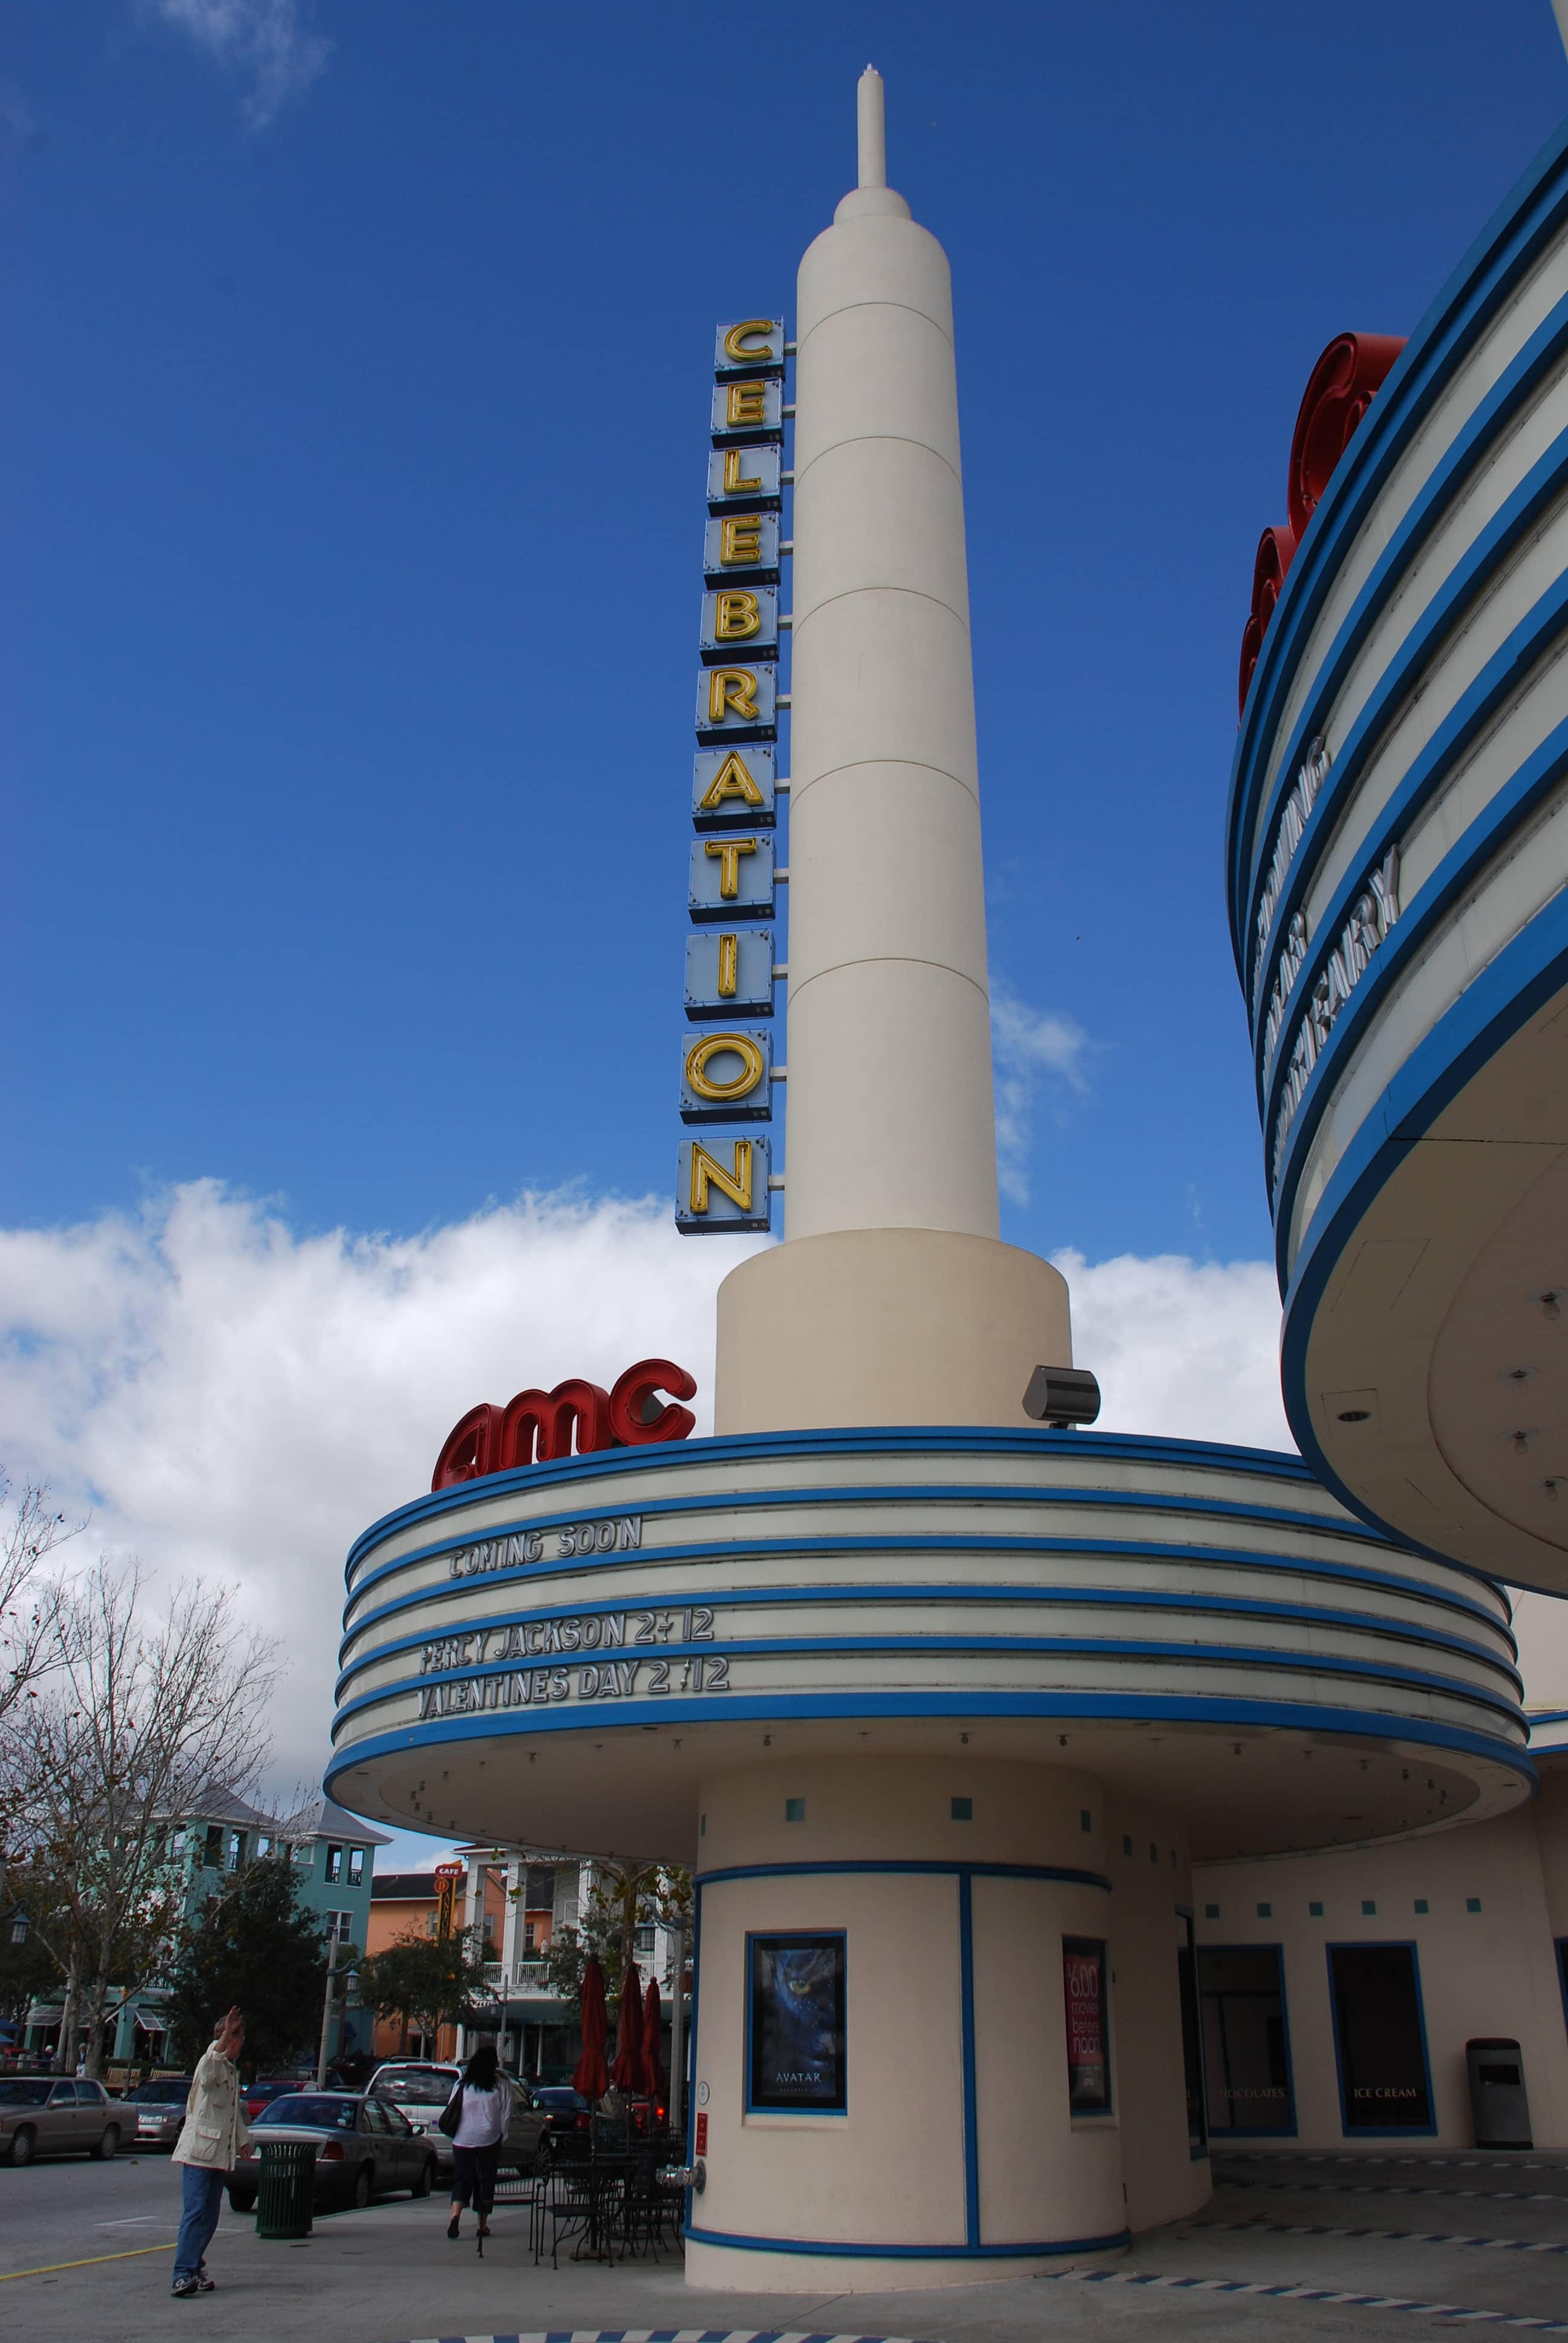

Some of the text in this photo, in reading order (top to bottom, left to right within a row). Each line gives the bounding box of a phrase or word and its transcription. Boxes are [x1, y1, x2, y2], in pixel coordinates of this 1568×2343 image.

[686, 319, 774, 1213] CELEBRATION
[449, 1516, 642, 1578] COMING SOON
[419, 1630, 491, 1674] PERCY
[493, 1613, 626, 1659] JACKSON
[417, 1665, 570, 1719] VALENTINES
[578, 1660, 641, 1698] DAY
[1071, 2001, 1099, 2014] movies
[1072, 2016, 1099, 2034] before
[1074, 2036, 1100, 2054] noon
[776, 2073, 822, 2082] AVATAR
[1354, 2087, 1417, 2098] ICE CREAM
